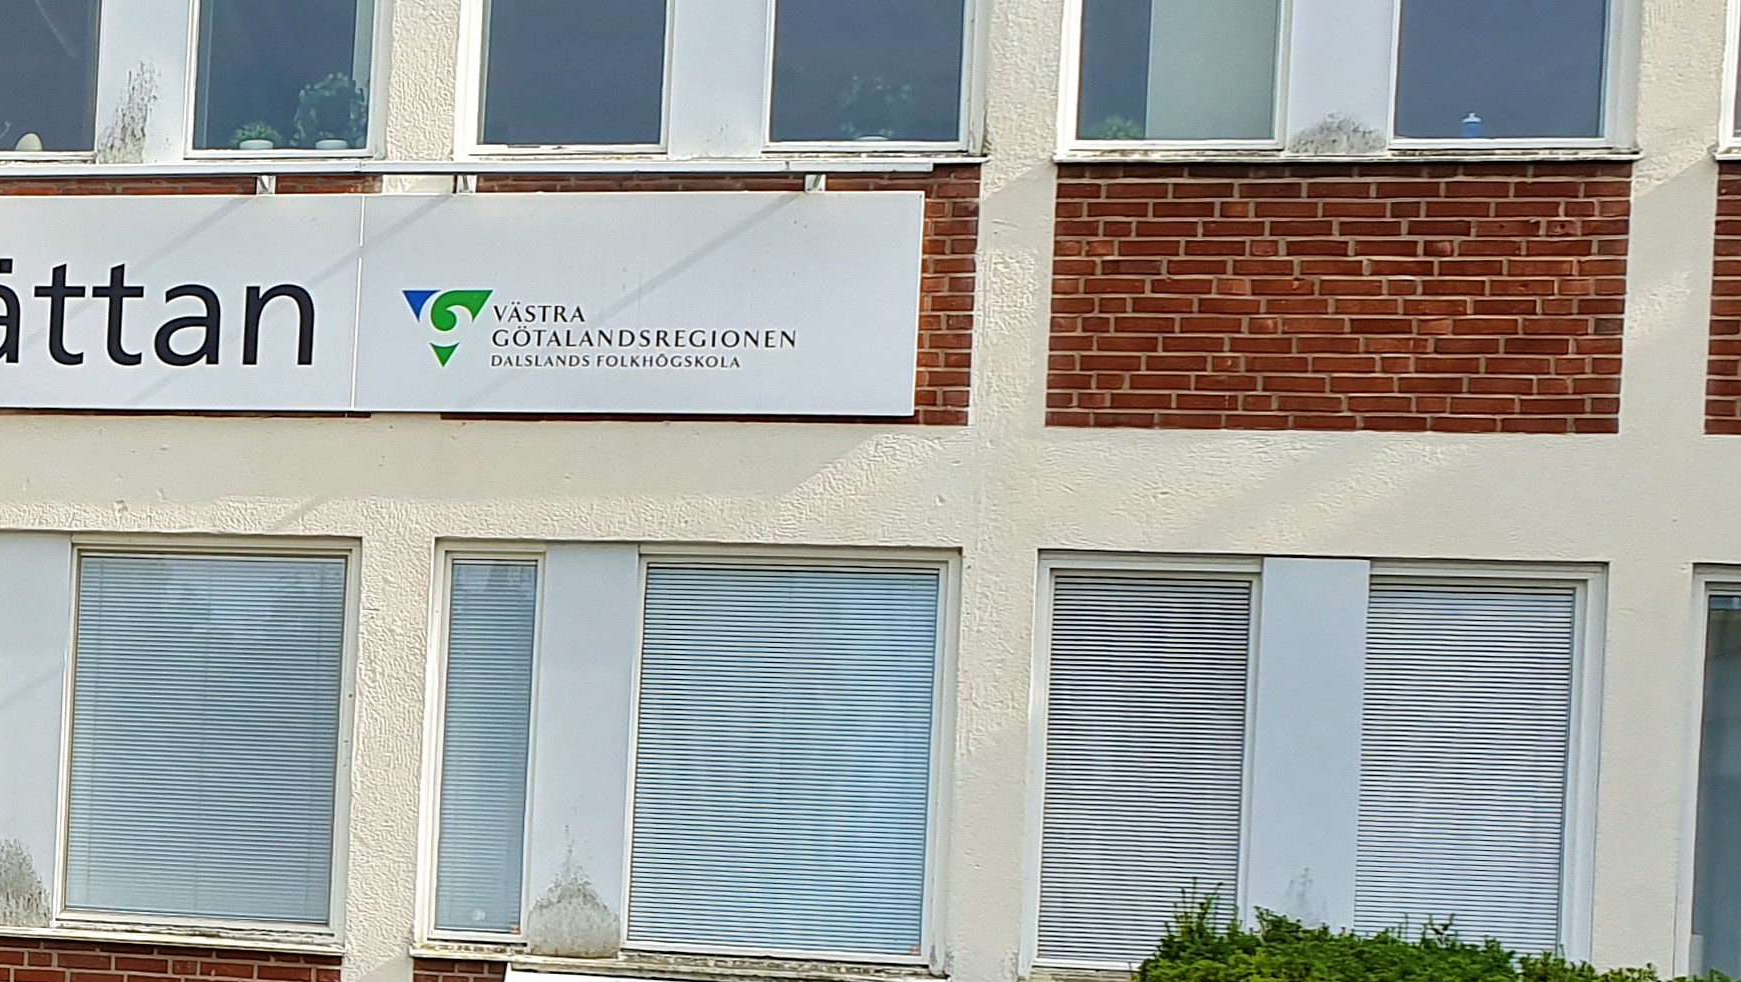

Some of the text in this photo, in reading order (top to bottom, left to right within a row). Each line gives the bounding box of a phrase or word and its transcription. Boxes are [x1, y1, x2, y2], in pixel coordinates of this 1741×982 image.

[493, 301, 585, 323] VÄSTRA
[491, 325, 797, 349] GÖTALANDSREGIONEN
[490, 352, 741, 369] DALSLANDS FOLKHÖGSKOLA
